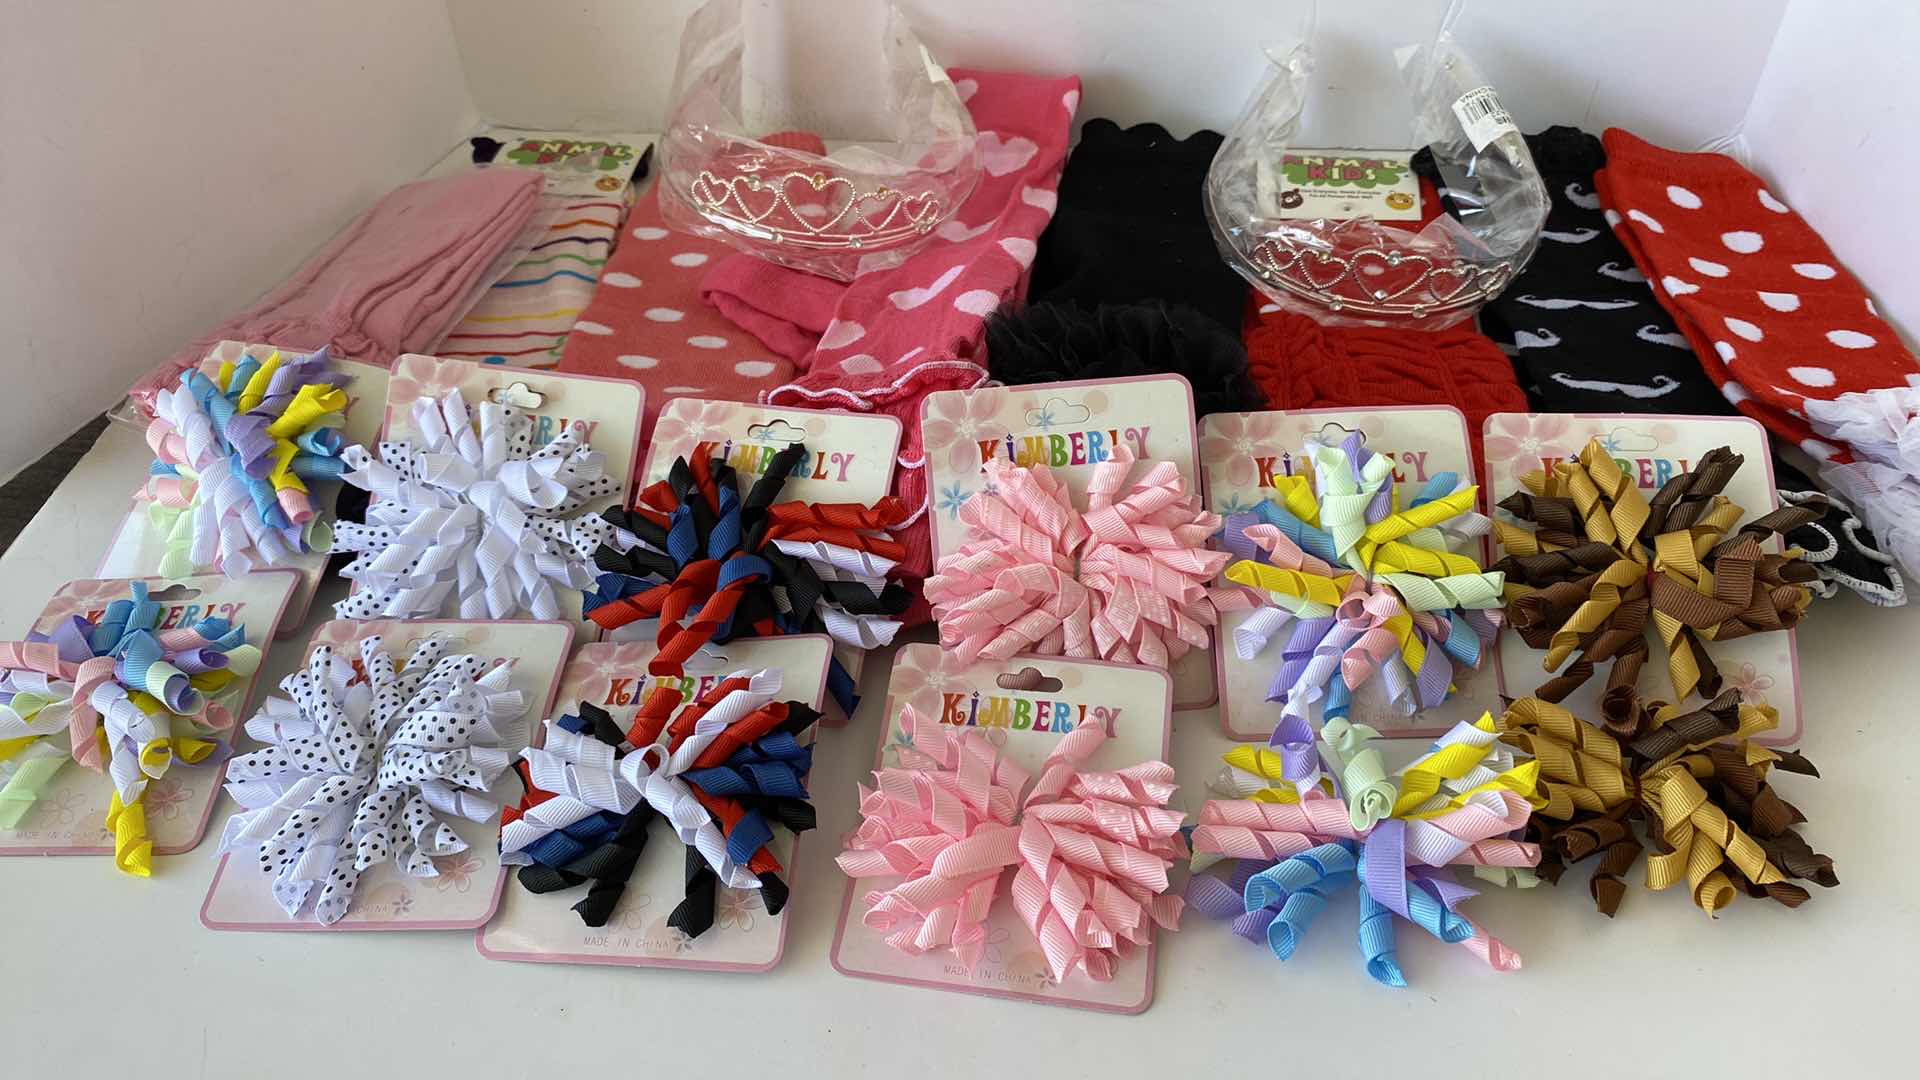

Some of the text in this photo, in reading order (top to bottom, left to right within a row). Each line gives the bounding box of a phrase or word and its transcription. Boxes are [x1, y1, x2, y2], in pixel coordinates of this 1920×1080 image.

[1310, 167, 1376, 180] KIDS
[583, 936, 669, 949] MADE IN CHINA
